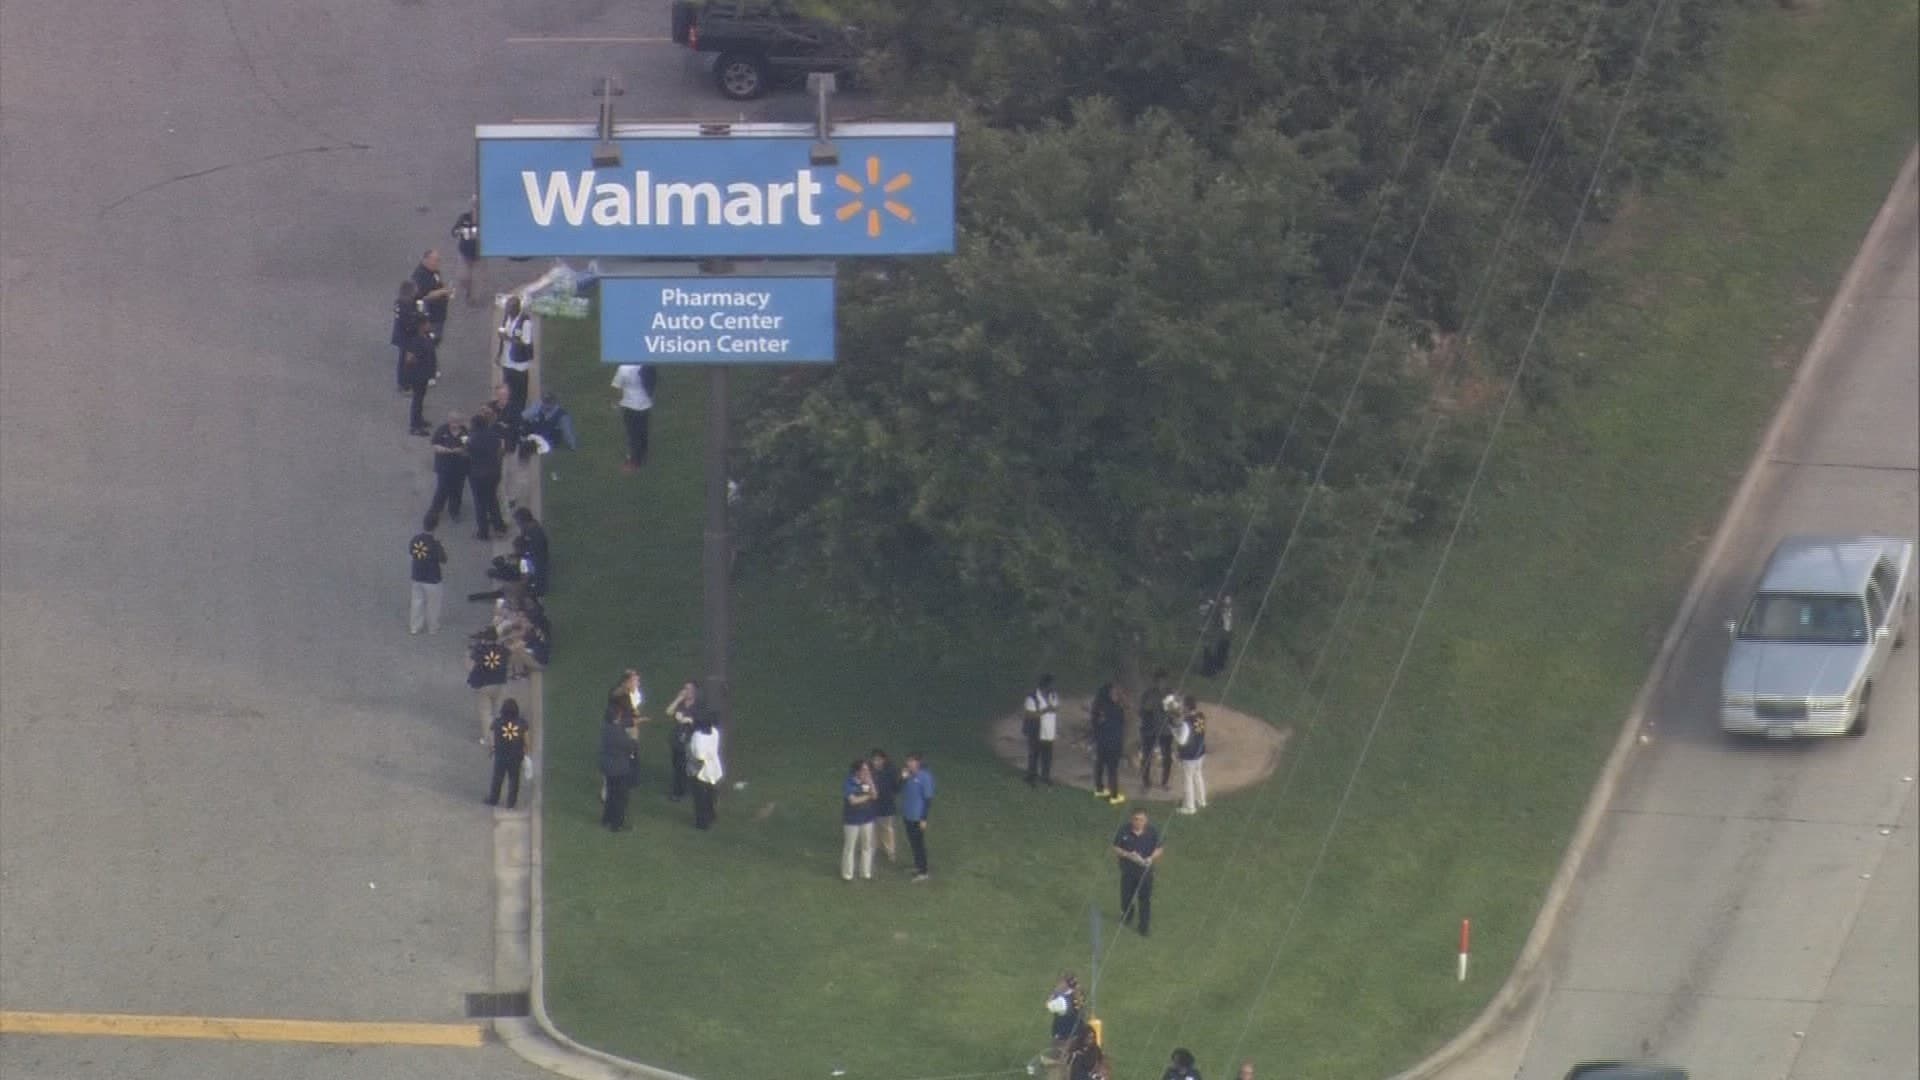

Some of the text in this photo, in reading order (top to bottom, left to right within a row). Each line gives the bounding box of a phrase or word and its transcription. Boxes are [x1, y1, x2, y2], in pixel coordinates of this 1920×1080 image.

[521, 169, 822, 226] Walmart
[661, 287, 771, 310] Pharmacy
[651, 311, 783, 330] Auto Center
[645, 335, 790, 353] Vision Center
